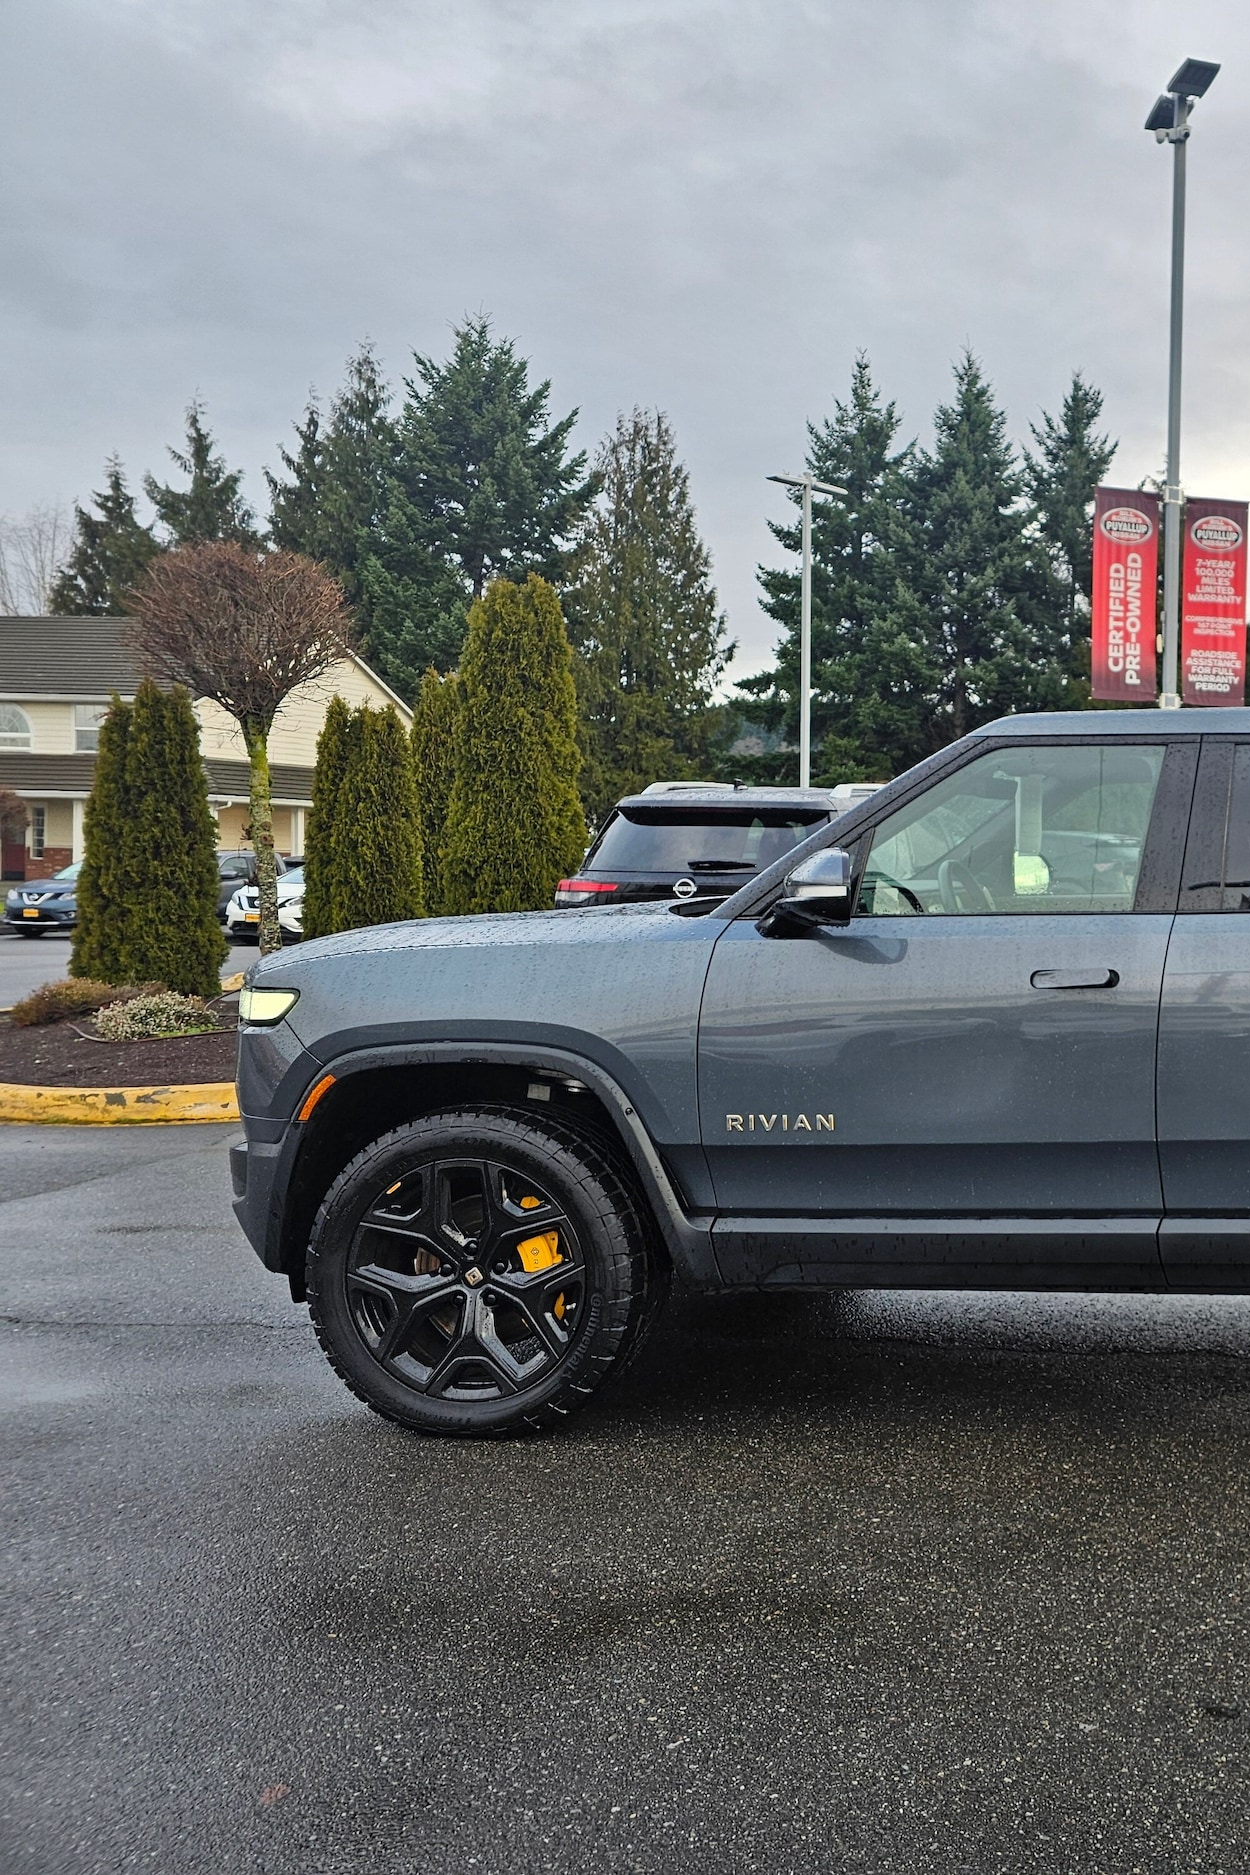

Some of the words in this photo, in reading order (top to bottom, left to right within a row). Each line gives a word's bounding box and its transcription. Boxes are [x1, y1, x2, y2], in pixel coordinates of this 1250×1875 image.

[1106, 521, 1148, 534] PUYALLUP
[1197, 530, 1238, 541] PUYALLUP
[1201, 576, 1230, 586] MILES
[1195, 585, 1235, 595] LIMITED
[1187, 593, 1242, 604] WARRANTY
[1108, 563, 1125, 672] CERTIFIED
[1125, 552, 1142, 686] PRE-OWNED
[1190, 649, 1238, 660] ROADSIDE
[1185, 657, 1242, 668] ASSISTANCE
[1191, 665, 1211, 674] FOR
[1212, 666, 1235, 676] FULL
[1187, 673, 1240, 685] WARRANTY
[1195, 682, 1230, 692] PERIOD
[726, 1113, 835, 1132] RIVIAN
[566, 1292, 603, 1371] Continental
